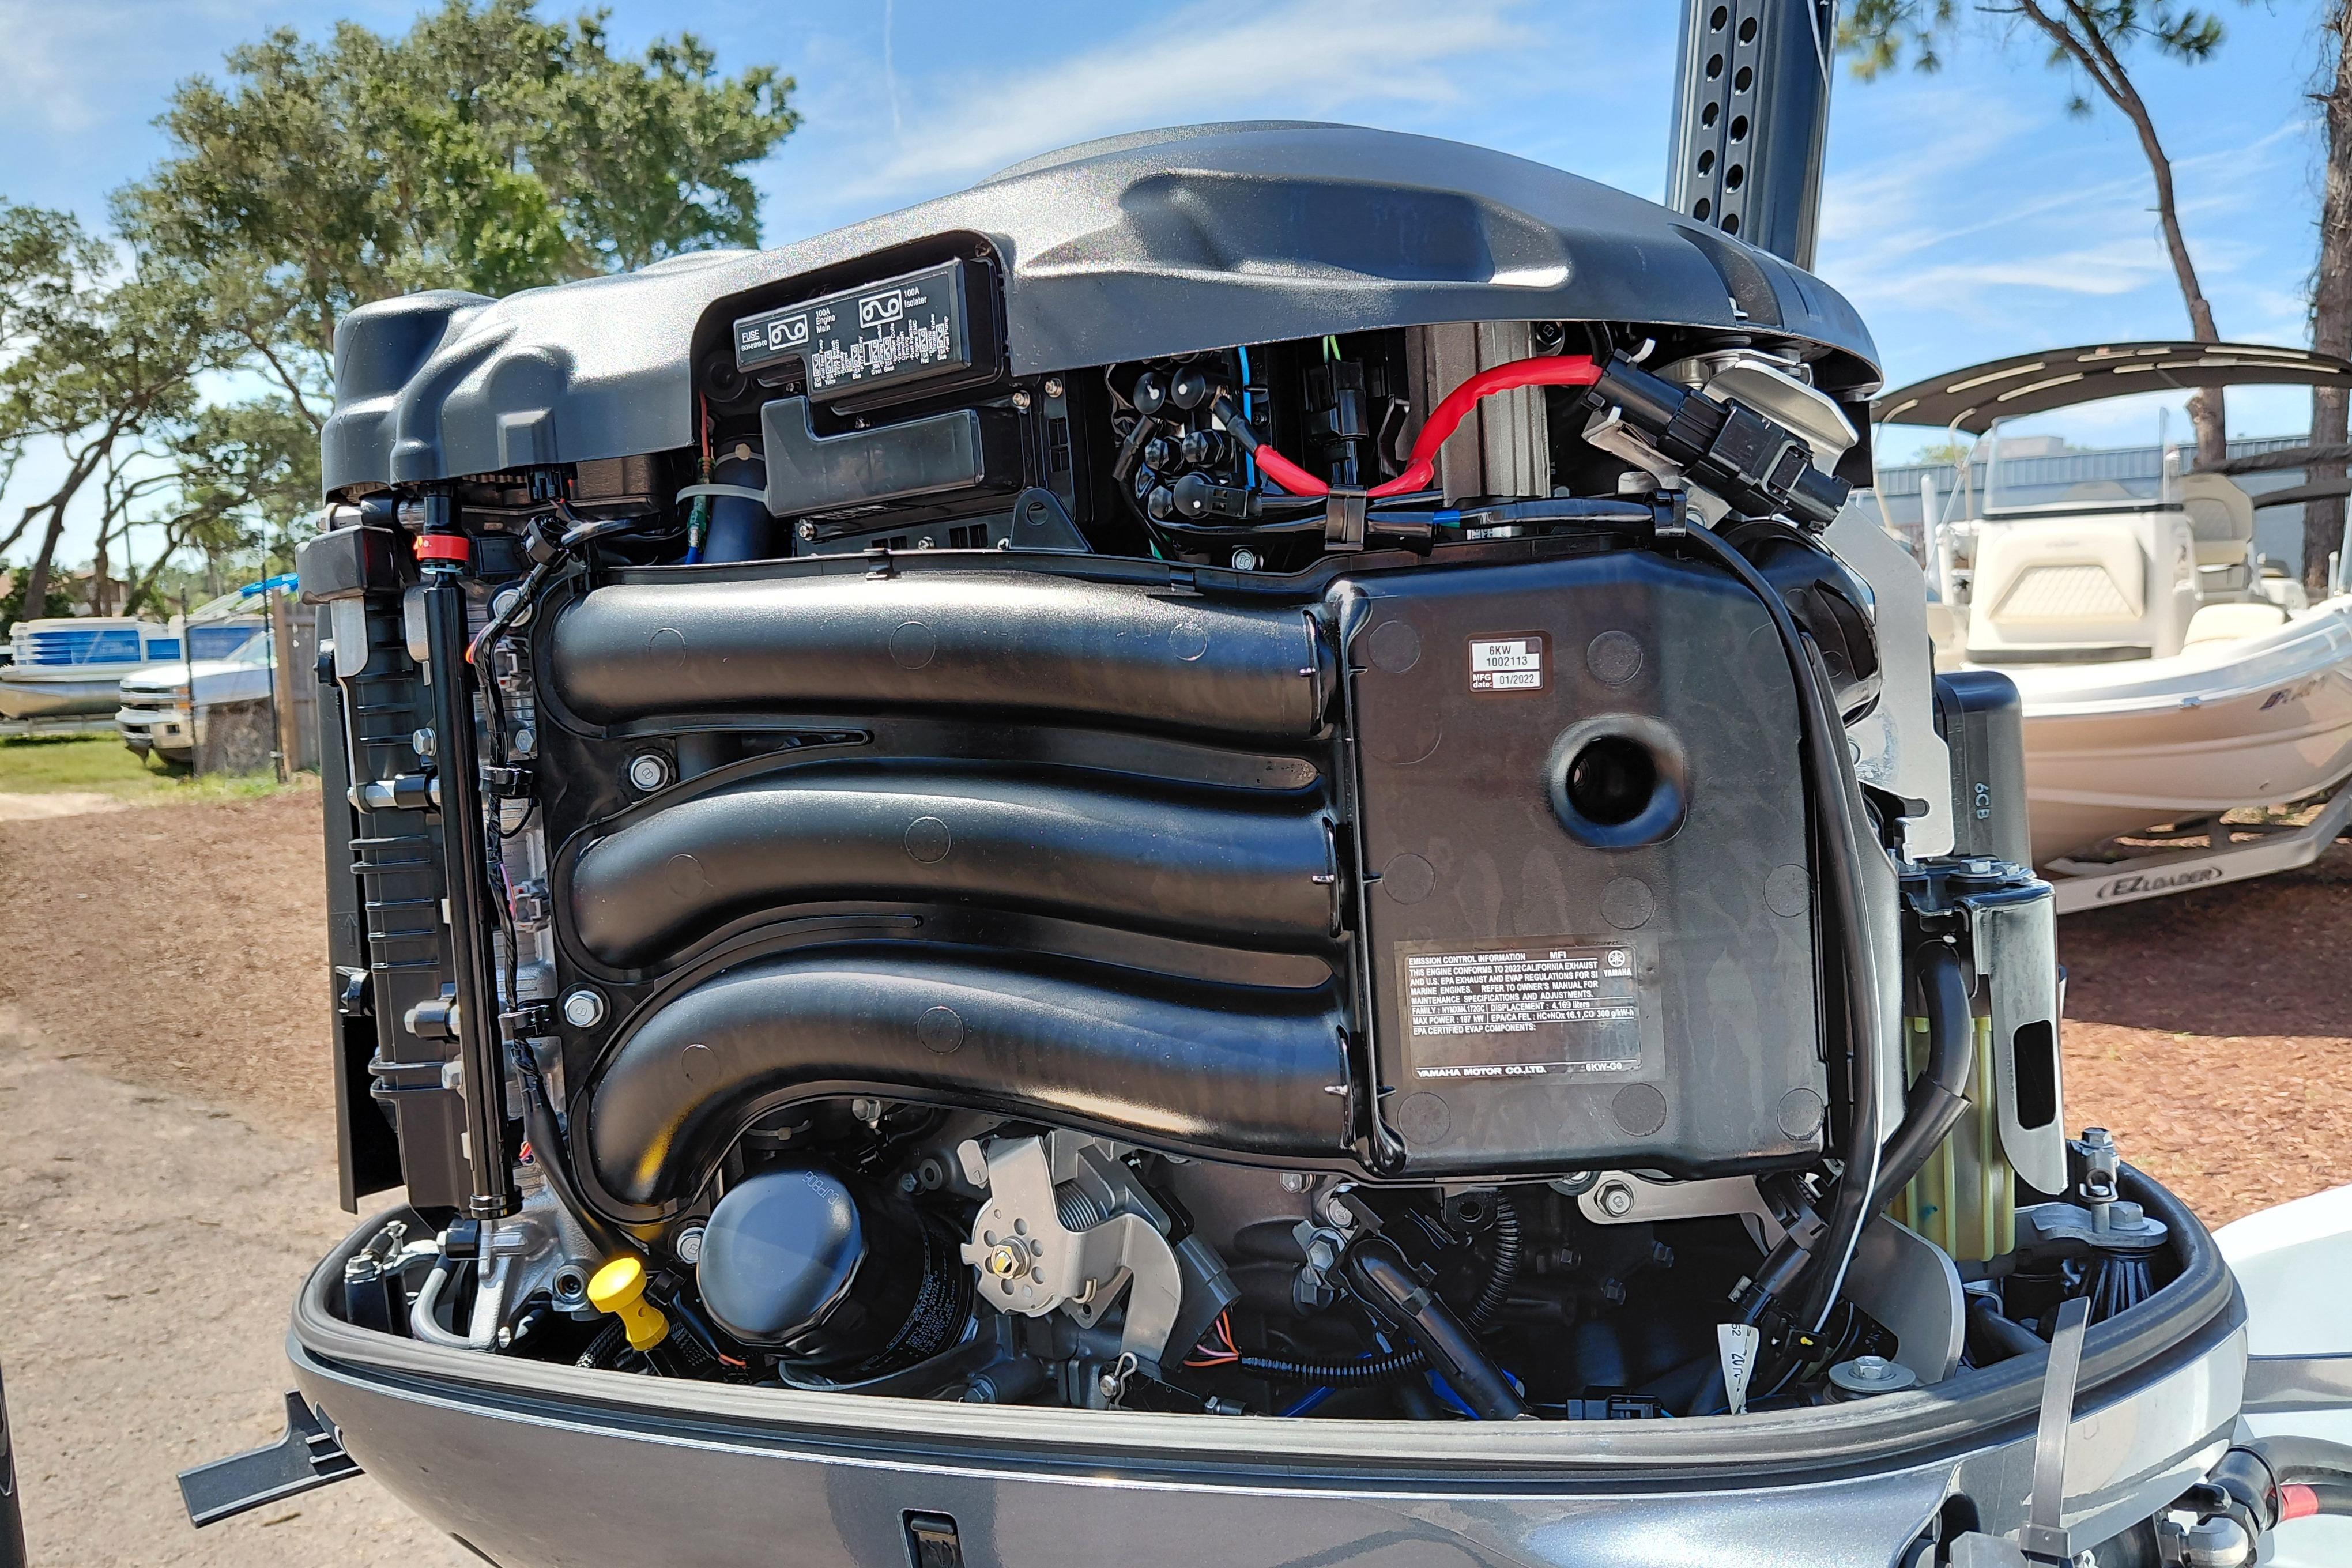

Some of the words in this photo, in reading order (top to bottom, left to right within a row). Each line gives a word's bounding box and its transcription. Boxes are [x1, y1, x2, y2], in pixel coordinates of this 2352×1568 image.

[904, 288, 919, 297] 100A
[904, 296, 928, 308] Isolater
[815, 308, 831, 318] 100A
[816, 315, 835, 326] Engine
[742, 329, 759, 340] FUSE
[816, 324, 831, 334] Main
[1489, 646, 1511, 655] 6KW
[1487, 656, 1528, 666] 1002113
[1500, 674, 1534, 684] 01/2022
[1974, 783, 1990, 819] 6CB
[1408, 957, 1441, 965] EMISSION
[1443, 955, 1477, 964] CONTROL
[1477, 953, 1526, 962] INFORMATION
[1550, 951, 1566, 959] MFI
[1409, 968, 1424, 977] THIS
[1426, 967, 1452, 976] ENGINE
[1453, 966, 1492, 975] CONFORMS
[1493, 965, 1503, 973] TO
[1504, 964, 1521, 973] 2022
[1522, 963, 1563, 972] CALIFORNIA
[1565, 961, 1598, 970] EXHAUST
[1603, 968, 1633, 977] YAMAHA
[1410, 978, 1424, 986] AND
[1426, 977, 1439, 986] U.S.
[1441, 977, 1454, 985] EPA
[1455, 975, 1487, 984] EXHAUST
[1488, 975, 1503, 983] AND
[1505, 974, 1523, 982] EVAP
[1525, 972, 1574, 981] REGULATIONS
[1574, 971, 1590, 979] FOR
[1590, 970, 1598, 978] SI
[1411, 987, 1437, 996] MARINE
[1440, 985, 1473, 994] ENGINES.
[1481, 984, 1505, 993] REFER
[1505, 983, 1515, 992] TO
[1516, 982, 1549, 991] OWNER'S
[1552, 981, 1582, 990] MANUAL
[1583, 980, 1599, 988] FOR
[1411, 995, 1461, 1005] MAINTENANCE
[1463, 993, 1520, 1003] SPECIFICATIONS
[1522, 992, 1537, 1000] AND
[1540, 990, 1594, 1000] ADJUSTMENTS.
[1551, 1001, 1571, 1009] 4.169
[1412, 1016, 1428, 1025] MAX
[1460, 1015, 1471, 1023] 197
[1473, 1015, 1484, 1023] kW
[1491, 1013, 1518, 1022] EPA/CA
[1537, 1012, 1565, 1020] HC+NOx
[1596, 1009, 1610, 1017] 300
[1611, 1009, 1634, 1018] g/kW-h
[1413, 1027, 1427, 1035] EPA
[1428, 1025, 1464, 1035] CERTIFIED
[1465, 1024, 1483, 1033] EVAP
[1484, 1023, 1536, 1032] COMPONENTS:
[1417, 1069, 1461, 1077] YAMAHA
[1463, 1068, 1502, 1076] MOTOR
[915, 1275, 934, 1321] CAUTION
[927, 1282, 937, 1309] LIGHTLY
[932, 1280, 940, 1306] BEFORE
